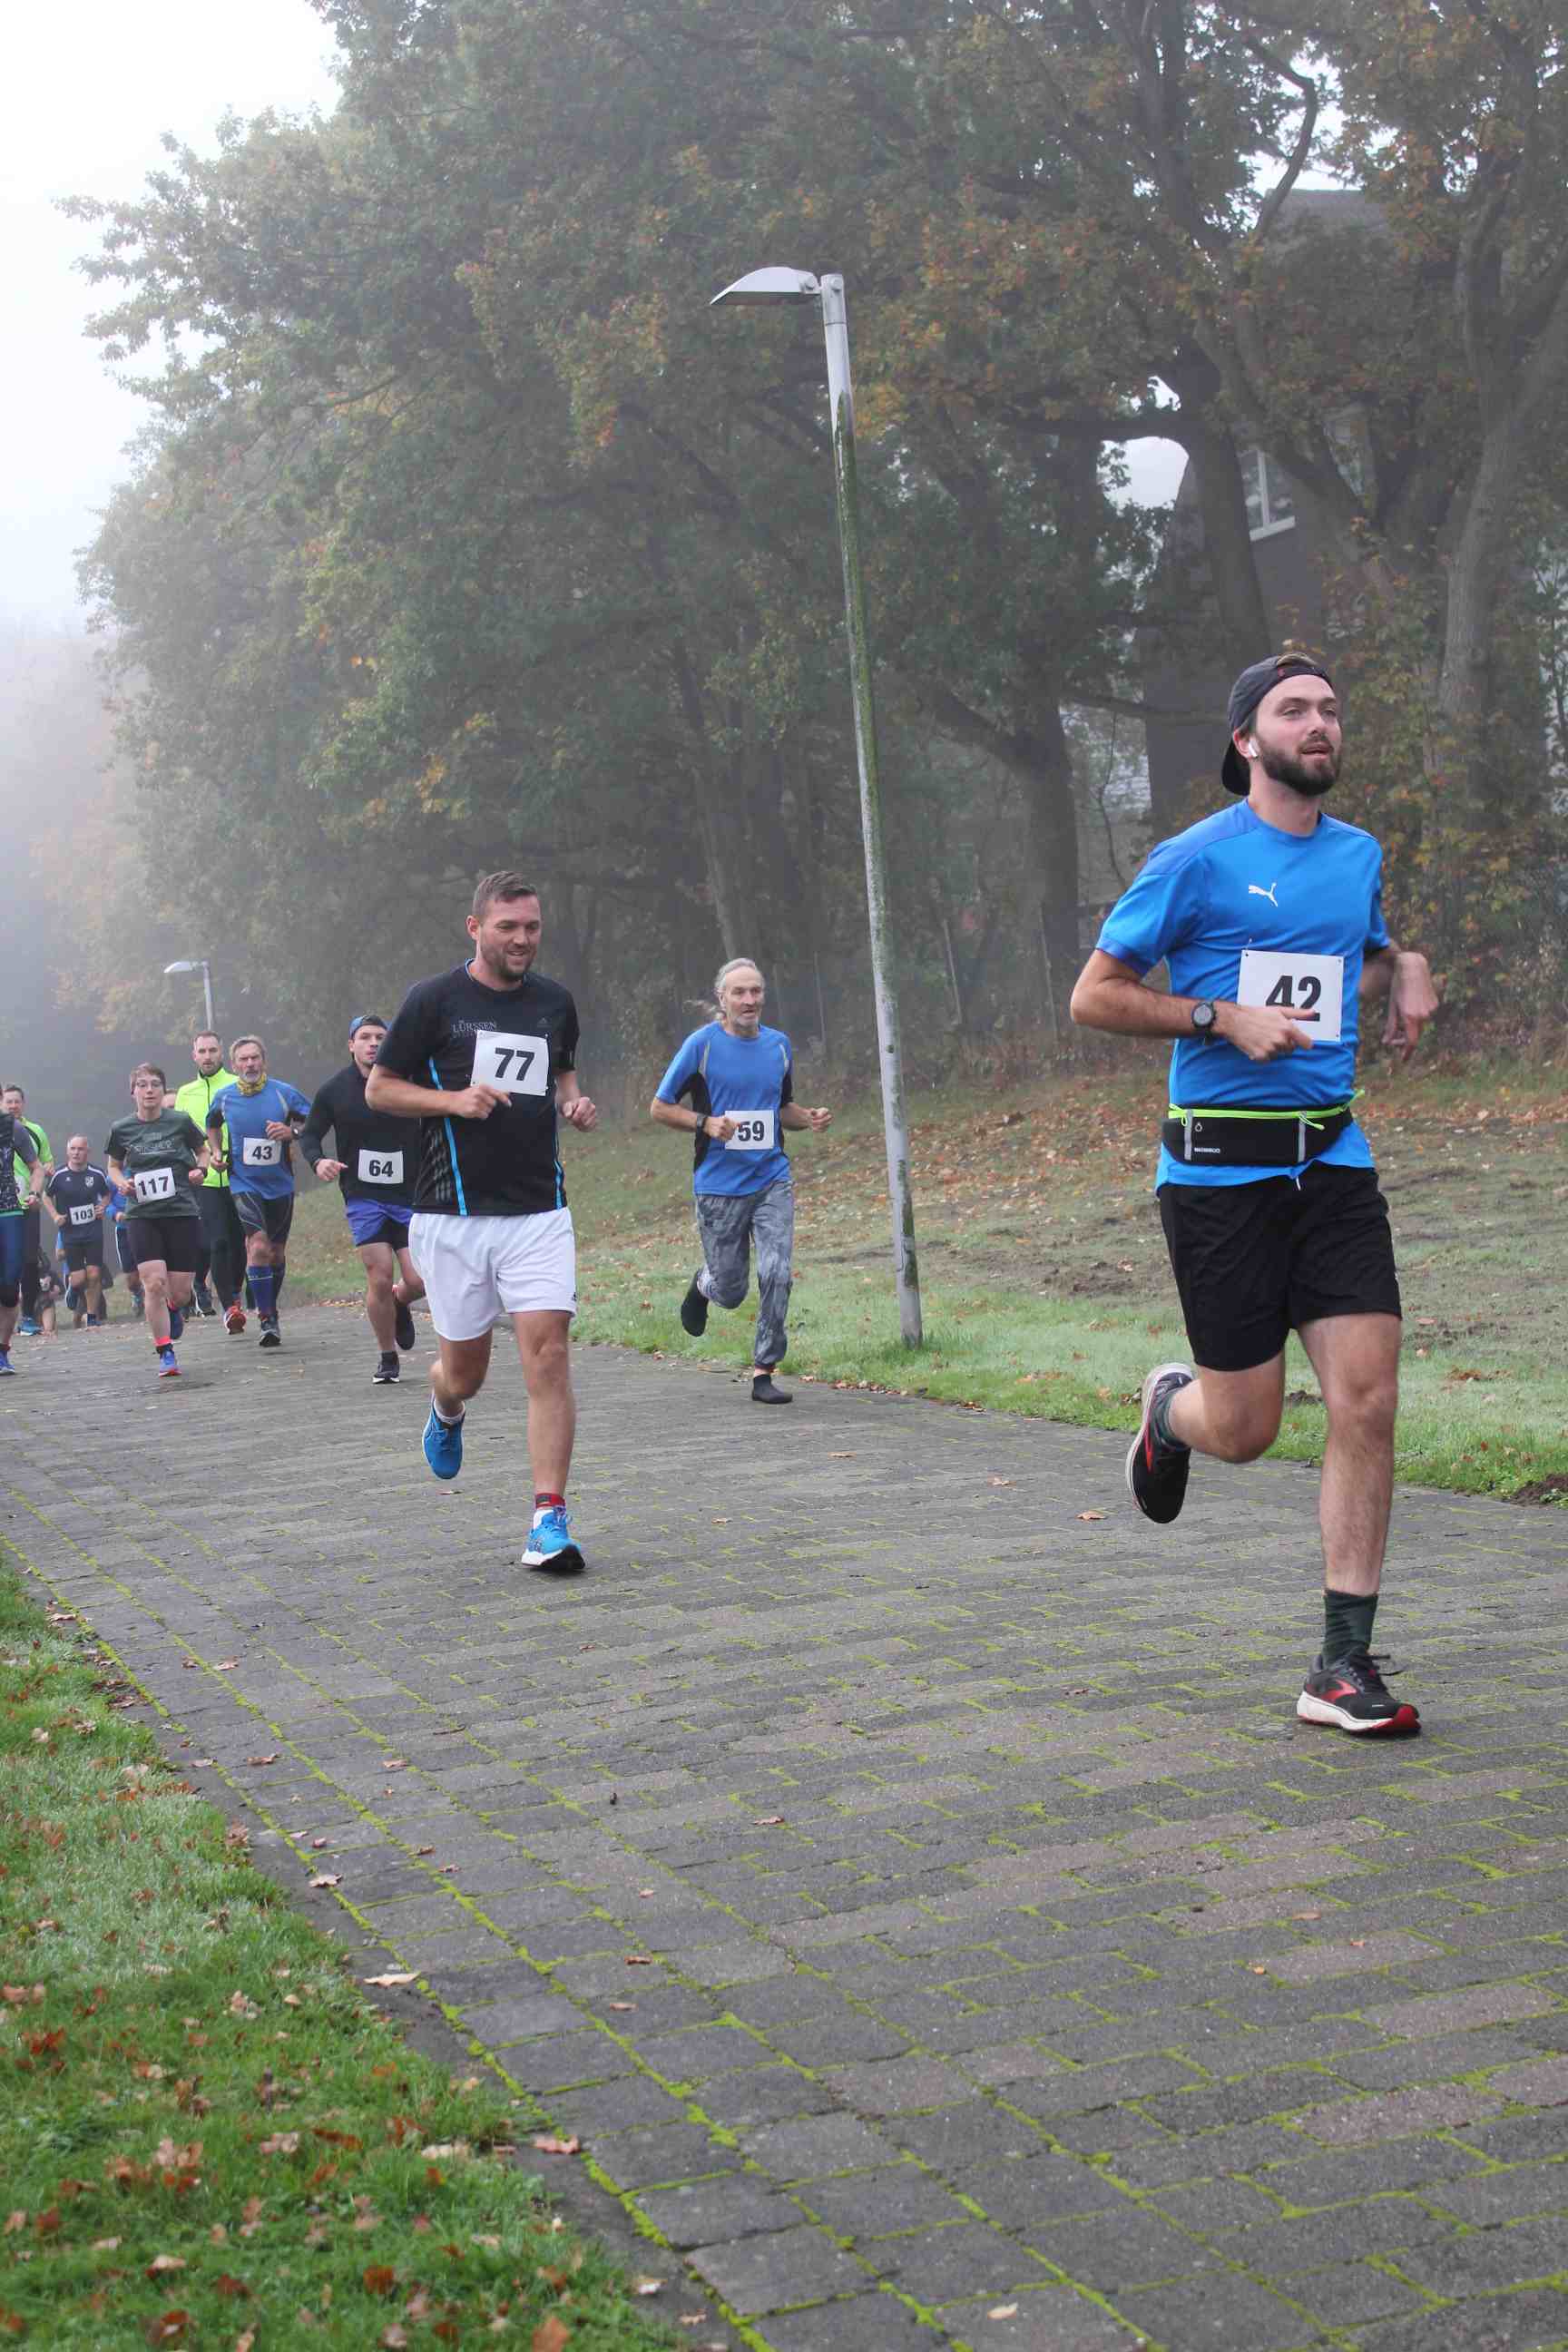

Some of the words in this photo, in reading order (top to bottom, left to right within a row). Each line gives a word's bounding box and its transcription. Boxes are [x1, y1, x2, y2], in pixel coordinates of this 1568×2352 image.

[1265, 975, 1321, 1022] 42
[495, 1047, 535, 1082] 77
[737, 1120, 765, 1142] 59
[252, 1145, 273, 1161] 43
[368, 1160, 394, 1178] 64
[138, 1176, 169, 1195] 117
[74, 1210, 93, 1220] 103
